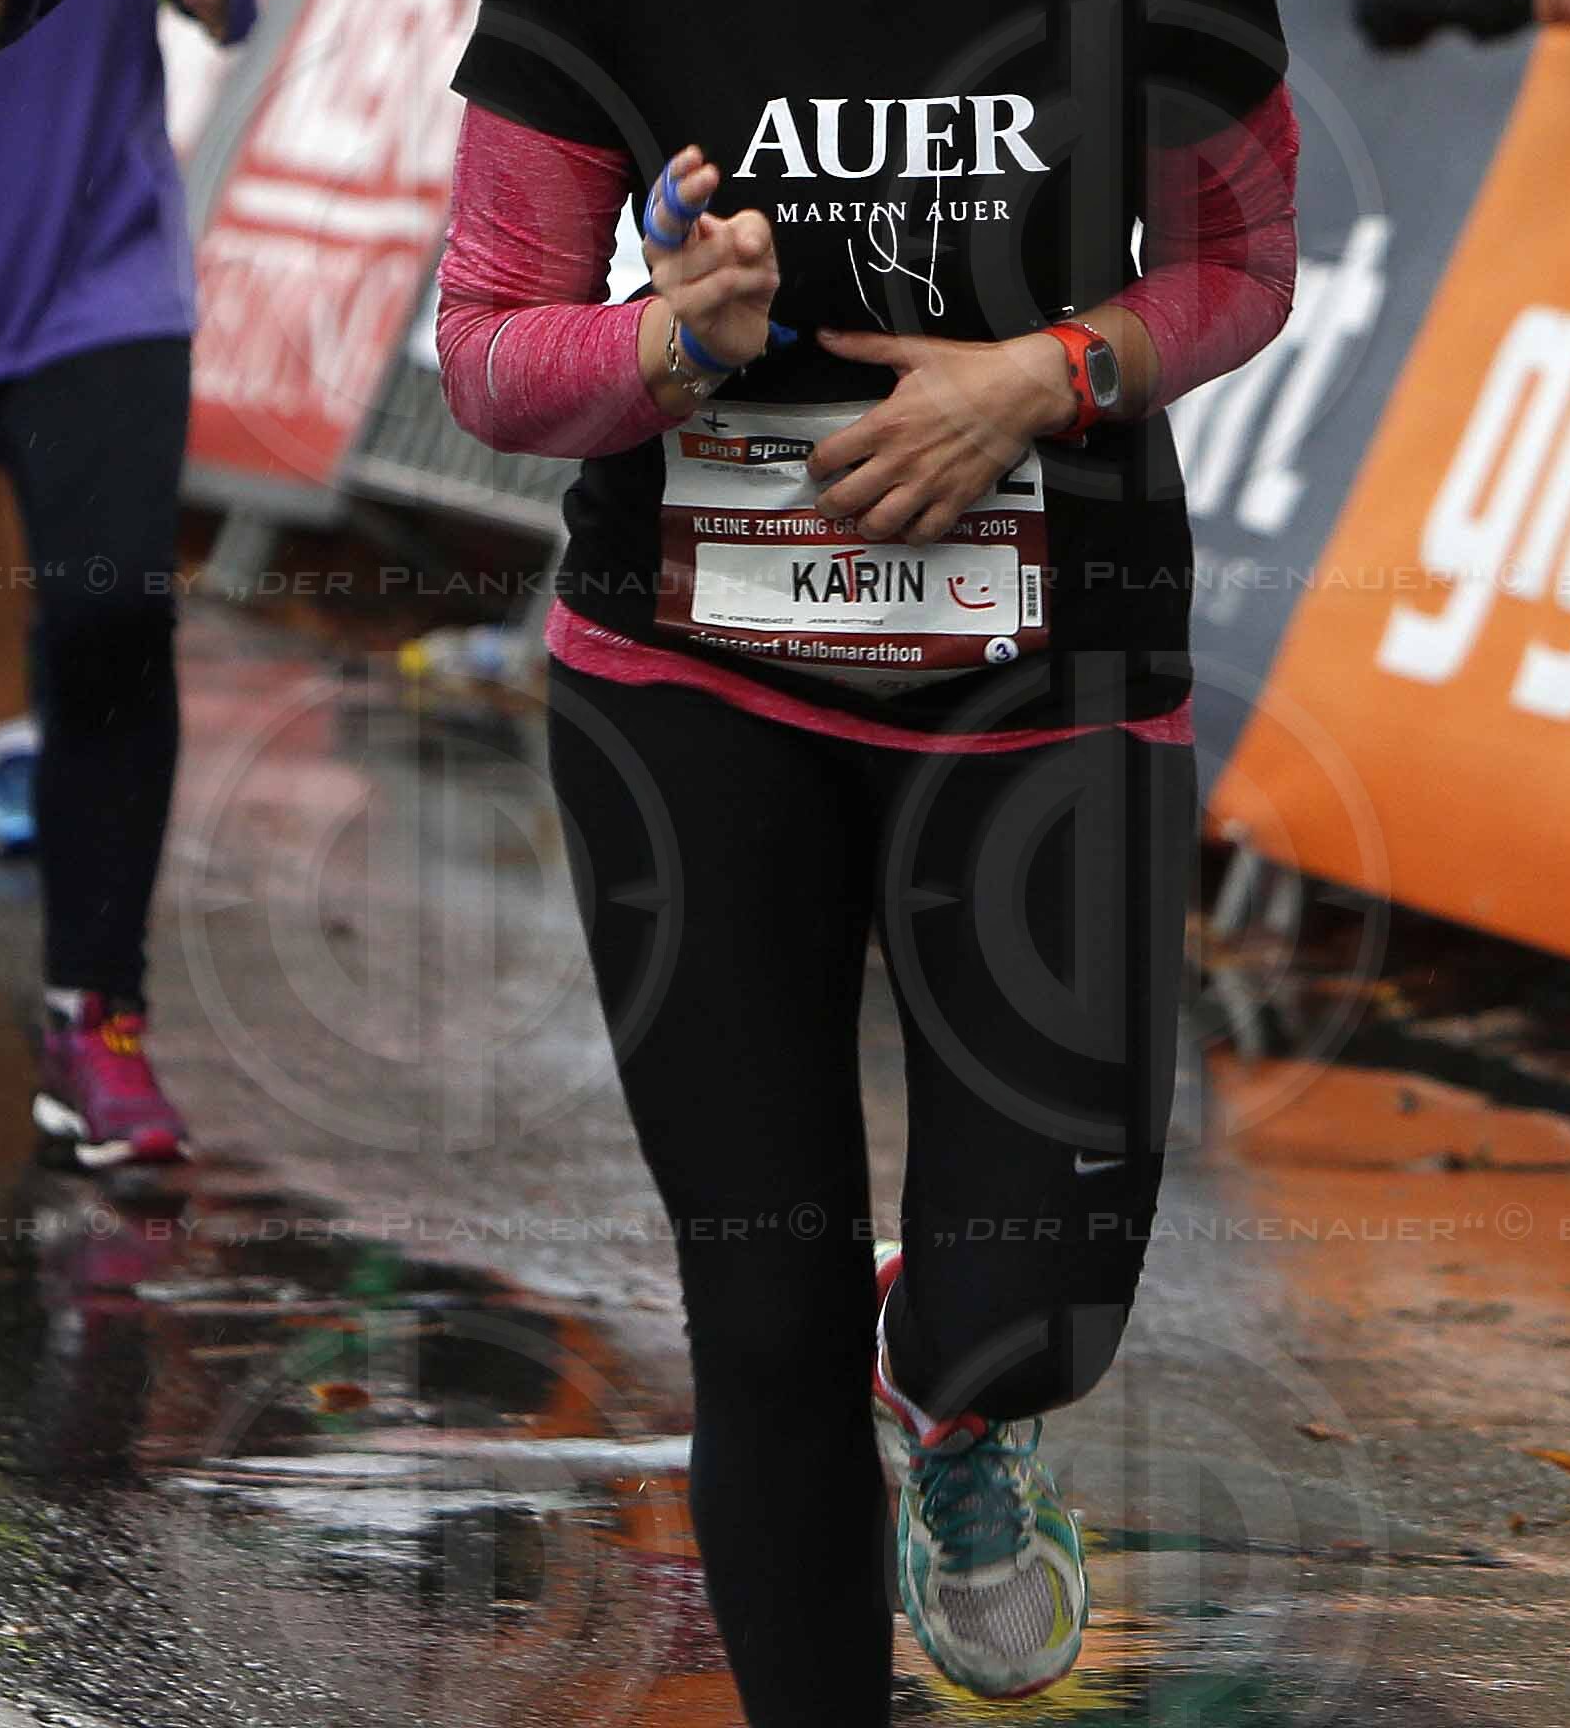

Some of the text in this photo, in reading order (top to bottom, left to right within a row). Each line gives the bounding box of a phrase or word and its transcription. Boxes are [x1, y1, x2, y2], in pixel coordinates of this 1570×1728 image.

[732, 94, 1051, 178] AUER
[776, 200, 1011, 223] MARTIN AUER
[693, 515, 750, 536] KLEINE
[755, 517, 829, 537] ZEITUNG
[979, 519, 1019, 537] 2015
[786, 640, 923, 664] Halbmarathon
